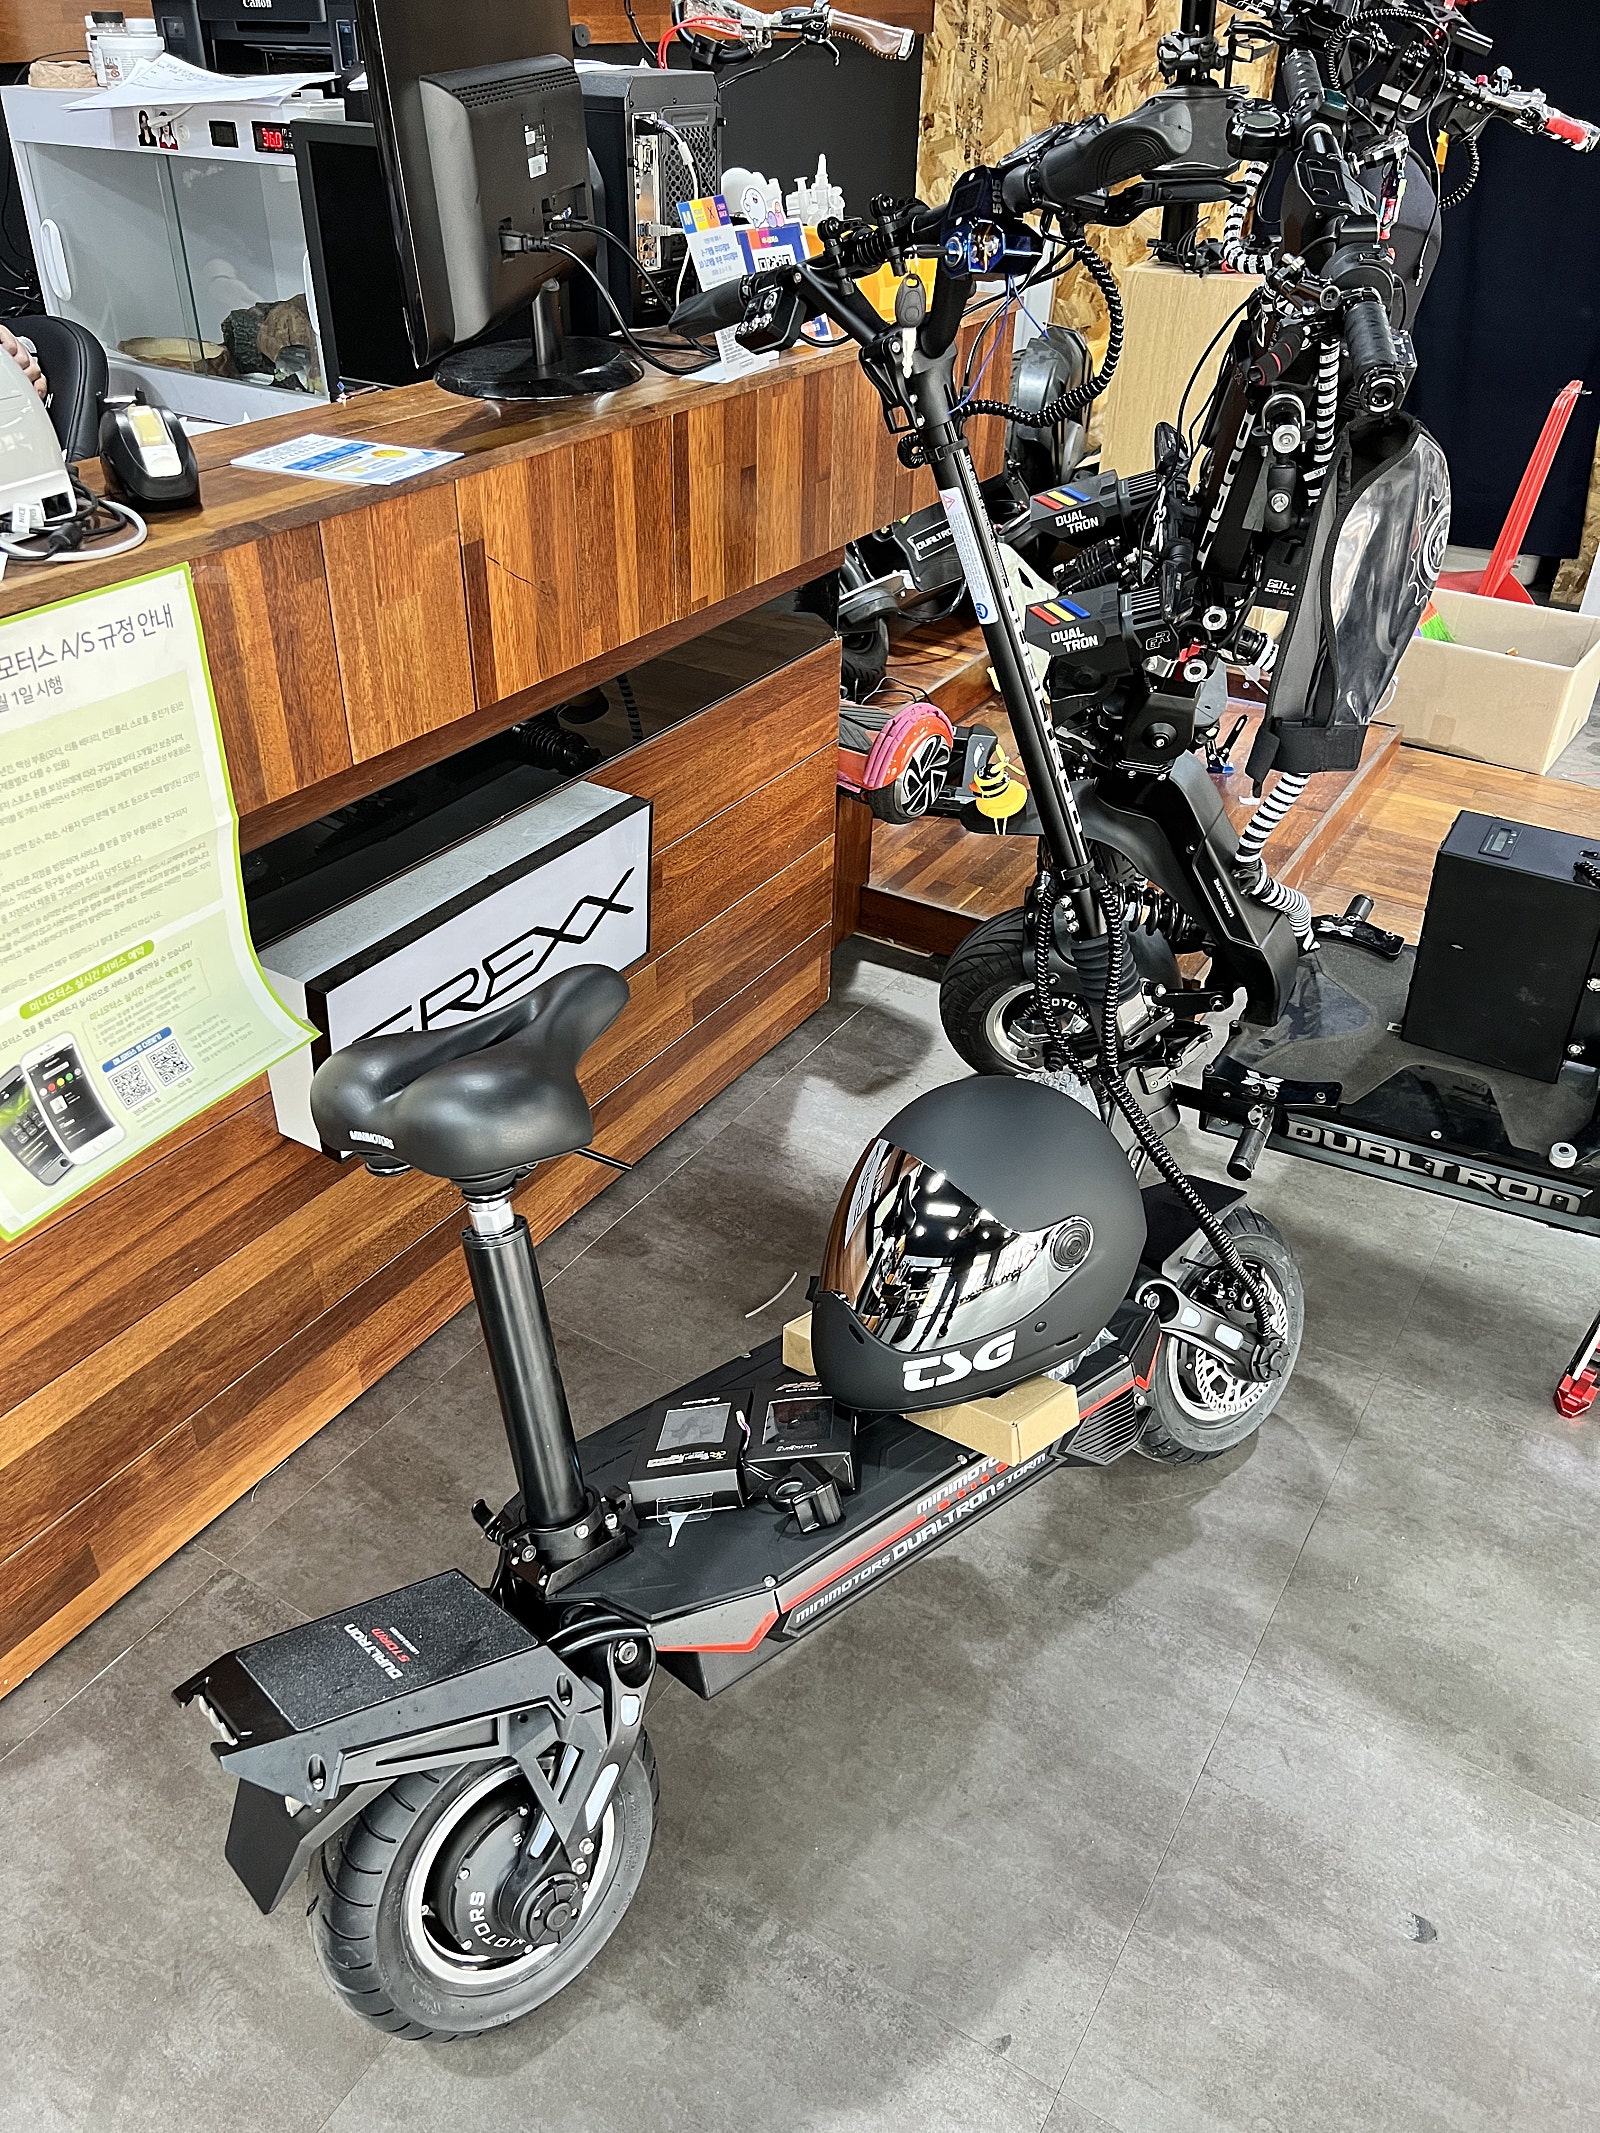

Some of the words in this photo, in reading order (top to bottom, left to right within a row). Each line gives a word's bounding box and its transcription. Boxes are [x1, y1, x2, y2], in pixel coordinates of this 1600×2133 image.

[992, 178, 1003, 214] 505
[1197, 407, 1256, 570] DUALT
[915, 528, 953, 551] DUALTRO
[1055, 509, 1087, 527] DUAL
[1066, 517, 1099, 534] TRON
[61, 630, 95, 662] A/S
[97, 617, 135, 650] 규정
[137, 605, 173, 636] 안내
[12, 686, 35, 705] 1일
[37, 677, 63, 697] 시행
[30, 984, 74, 1012] 미니모터스
[75, 969, 101, 989] 실시간
[102, 955, 128, 975] 서비스
[350, 1130, 394, 1149] MINIMOTORS
[1286, 1121, 1581, 1214] DUALTRON
[902, 1329, 1017, 1392] TSG
[892, 1484, 997, 1561] DUALTRON
[996, 1452, 1046, 1491] STORM
[916, 1457, 1000, 1514] MINIMOTO
[344, 1623, 403, 1680] DUALTRON
[371, 1628, 411, 1663] STORM
